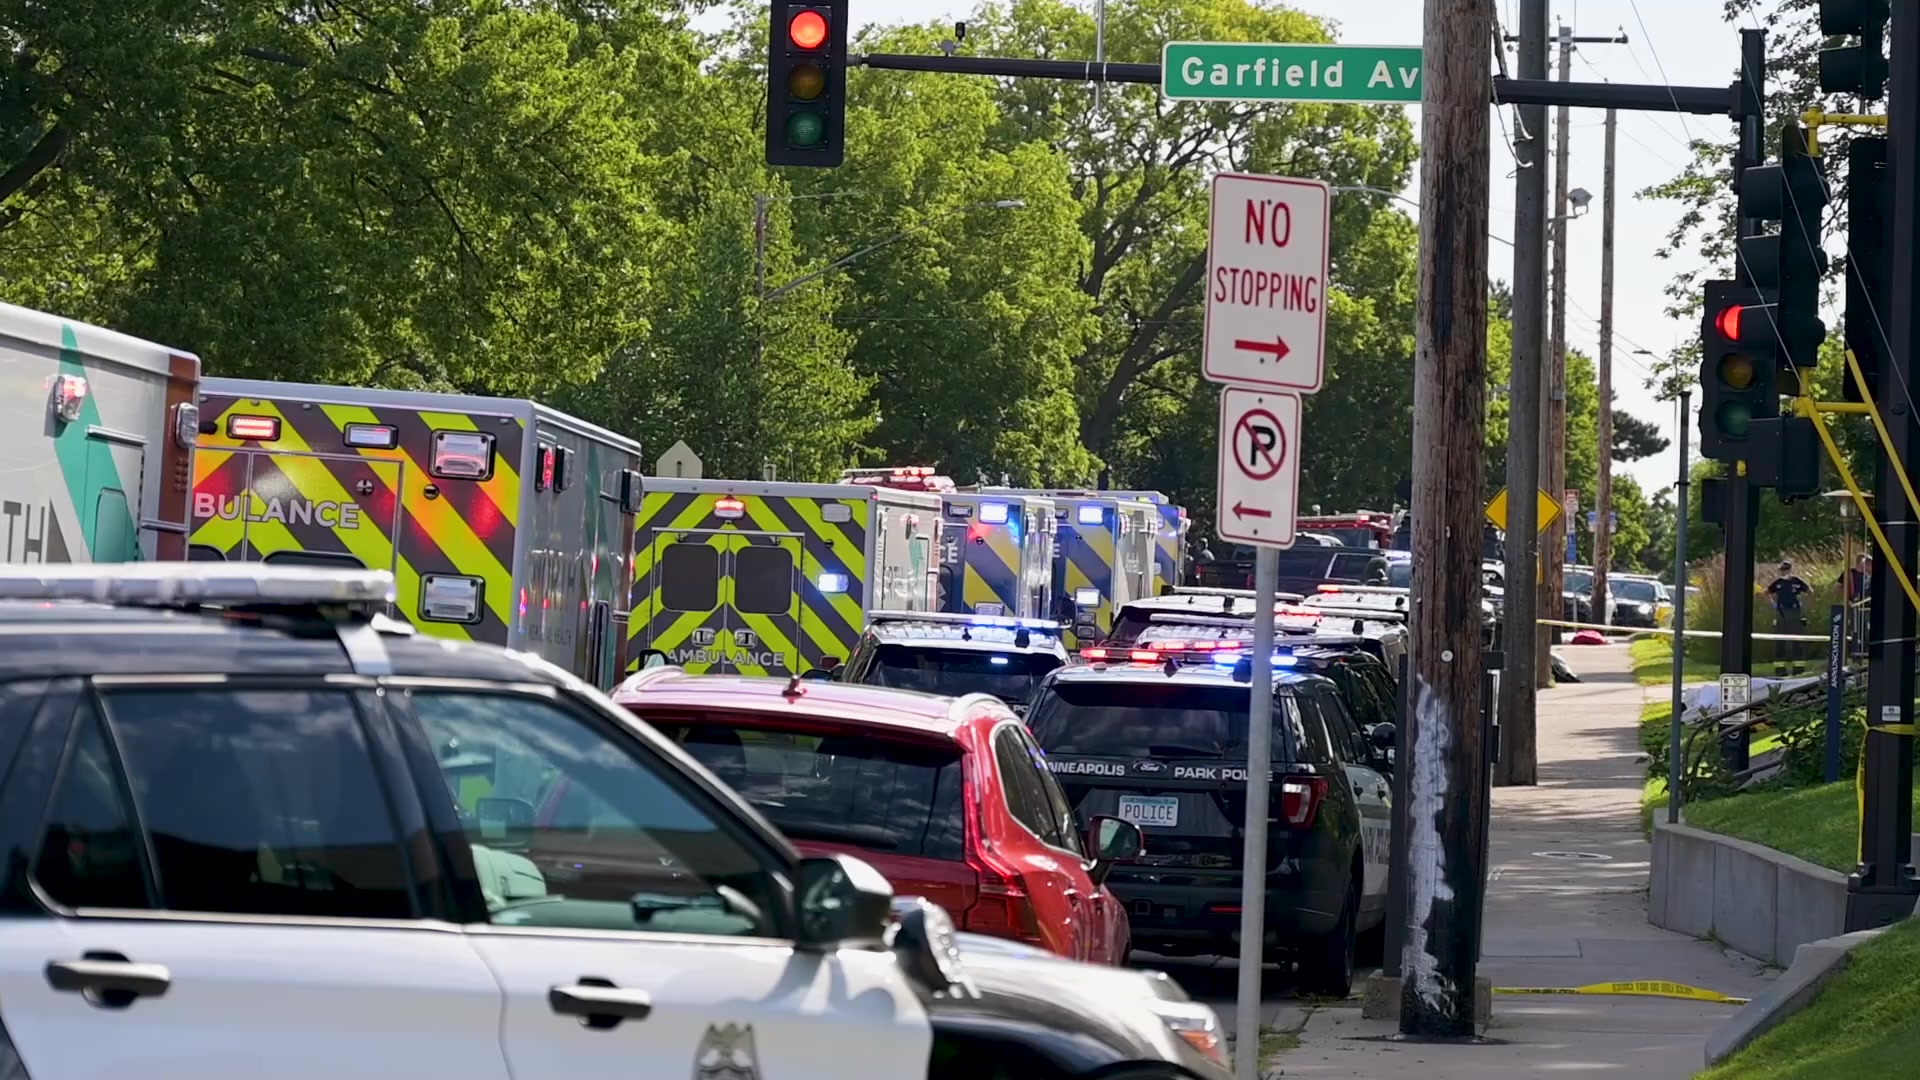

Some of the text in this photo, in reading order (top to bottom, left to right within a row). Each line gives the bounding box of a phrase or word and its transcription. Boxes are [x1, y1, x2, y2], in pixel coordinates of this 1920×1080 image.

[1181, 56, 1419, 89] Garfield Av
[1245, 199, 1291, 248] NO
[1215, 266, 1317, 313] STOPPING
[667, 649, 784, 667] AMBULANCE
[1175, 767, 1273, 782] PARK POLE
[1124, 804, 1174, 820] POLICE
